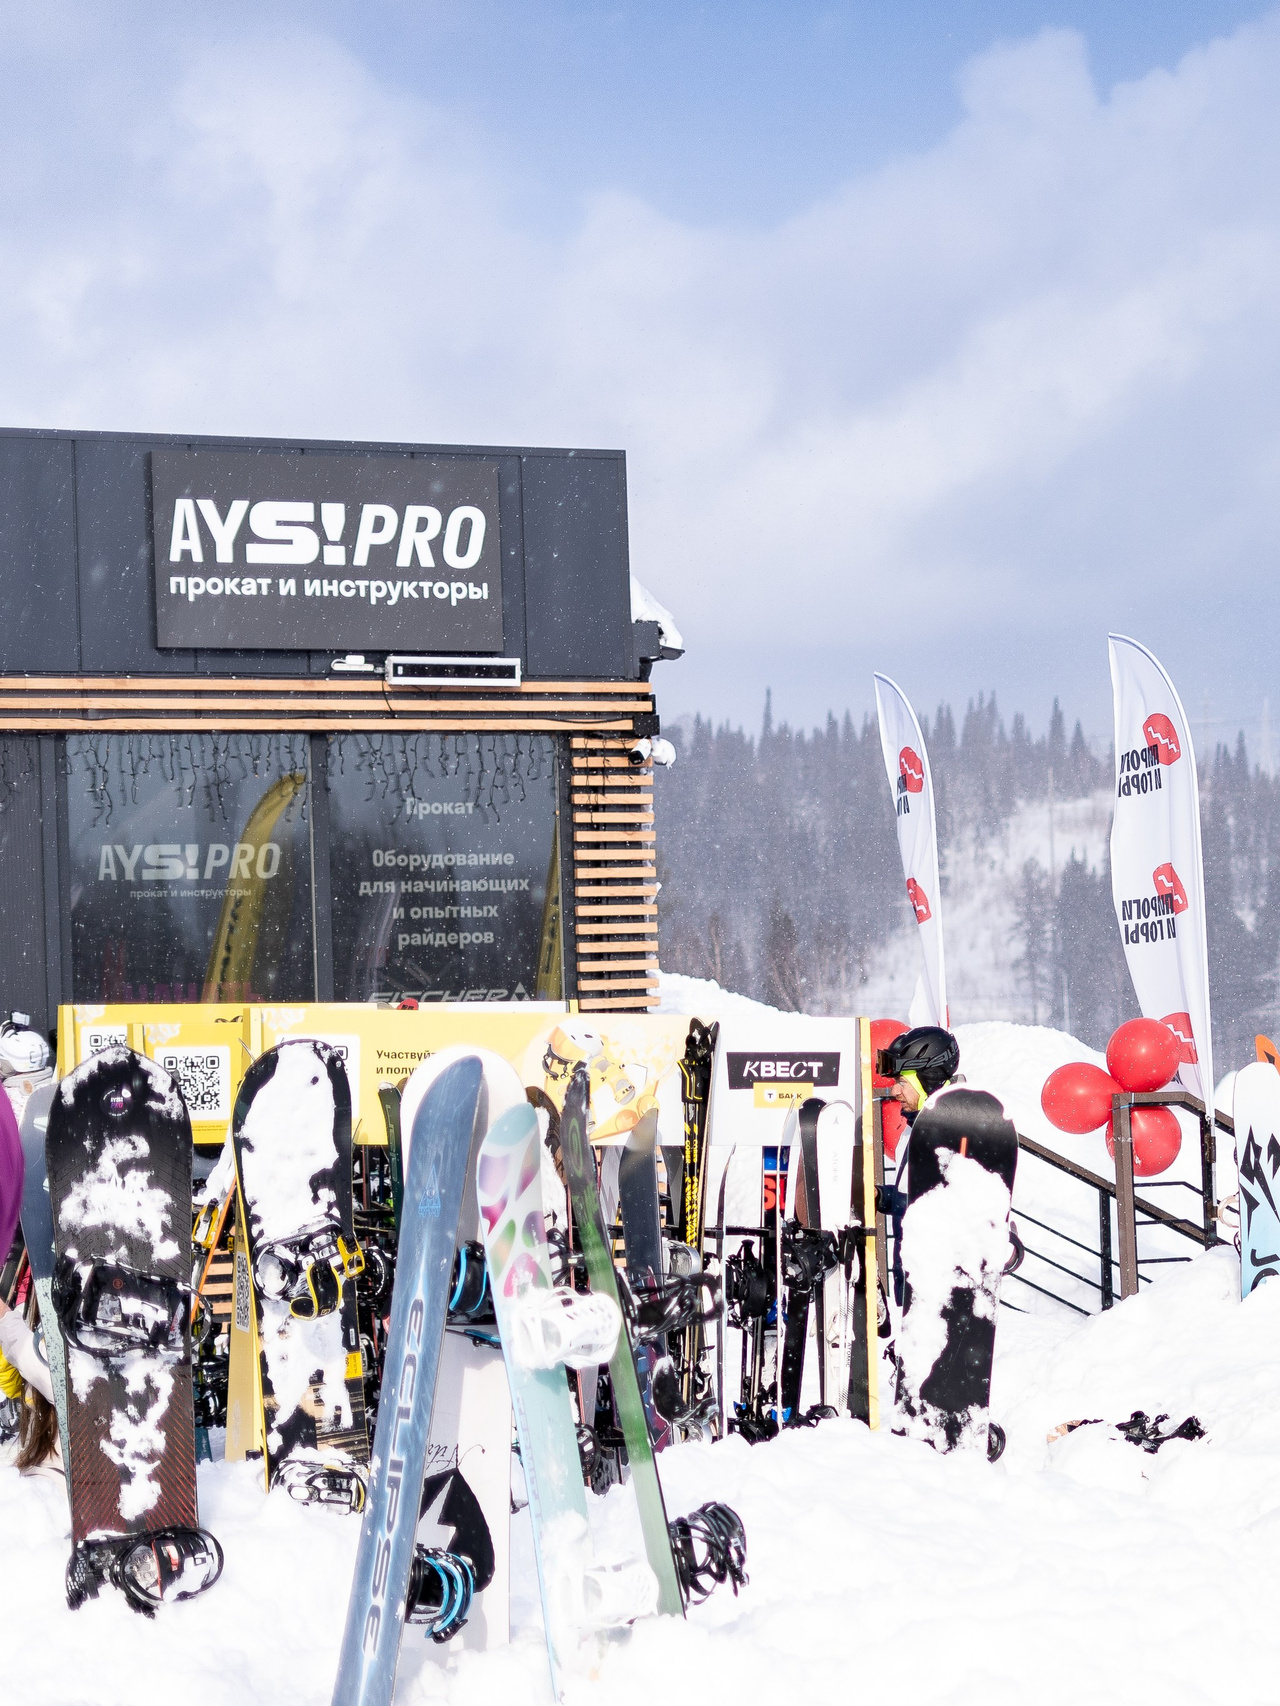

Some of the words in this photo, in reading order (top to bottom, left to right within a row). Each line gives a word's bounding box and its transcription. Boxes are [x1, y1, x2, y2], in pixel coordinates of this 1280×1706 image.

[169, 575, 272, 602] прокат
[278, 578, 296, 596] и
[304, 578, 489, 606] инструкторы
[406, 797, 475, 820] Прокат
[372, 850, 515, 872] Оборудование
[130, 889, 168, 899] прокат
[359, 880, 396, 896] для
[400, 879, 530, 894] начинающих
[393, 907, 405, 919] и
[410, 905, 499, 919] опытных
[397, 928, 495, 950] райдеров
[376, 1049, 437, 1062] Участвуй
[376, 1067, 384, 1075] и
[386, 1066, 418, 1077] полу
[743, 1061, 824, 1078] КВЕСТ
[362, 1298, 426, 1655] ECLIPSE
